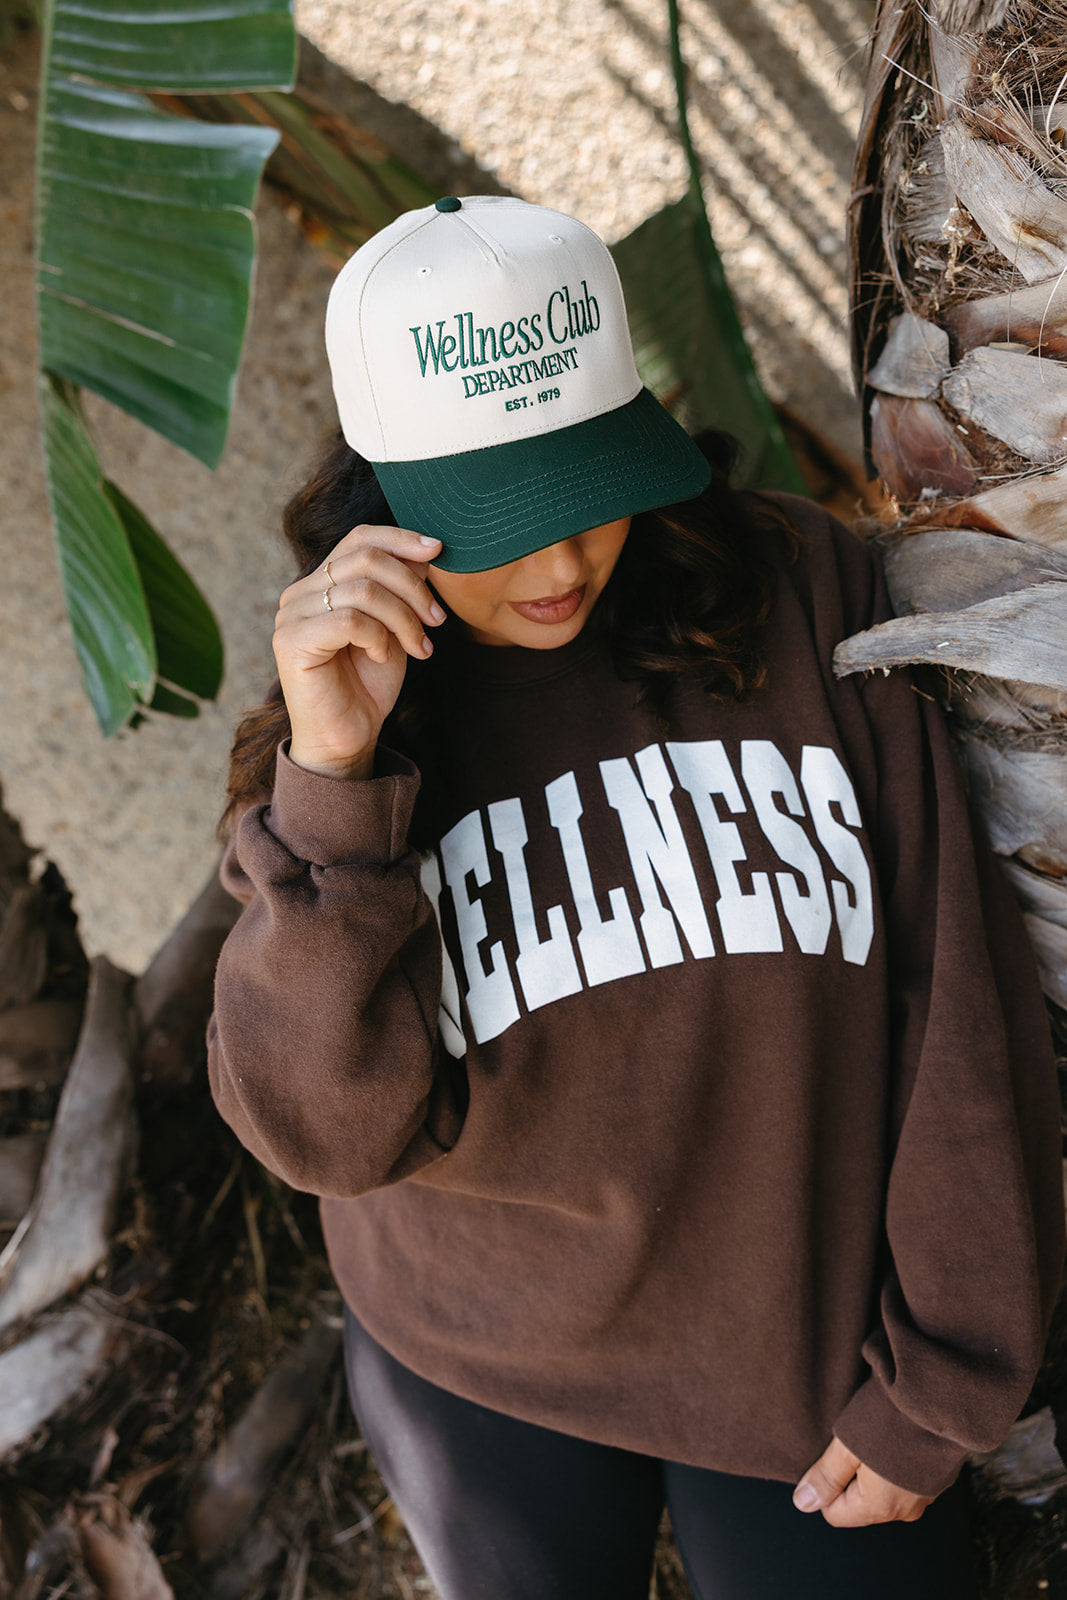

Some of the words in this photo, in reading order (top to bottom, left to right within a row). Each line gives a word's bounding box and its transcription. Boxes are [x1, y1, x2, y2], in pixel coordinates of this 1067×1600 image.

[409, 312, 543, 378] Wellness
[547, 280, 600, 344] Club
[461, 347, 578, 398] DEPARTMENT
[505, 396, 534, 412] EST.
[538, 387, 561, 404] 1979
[420, 739, 874, 1059] ELLNESS
